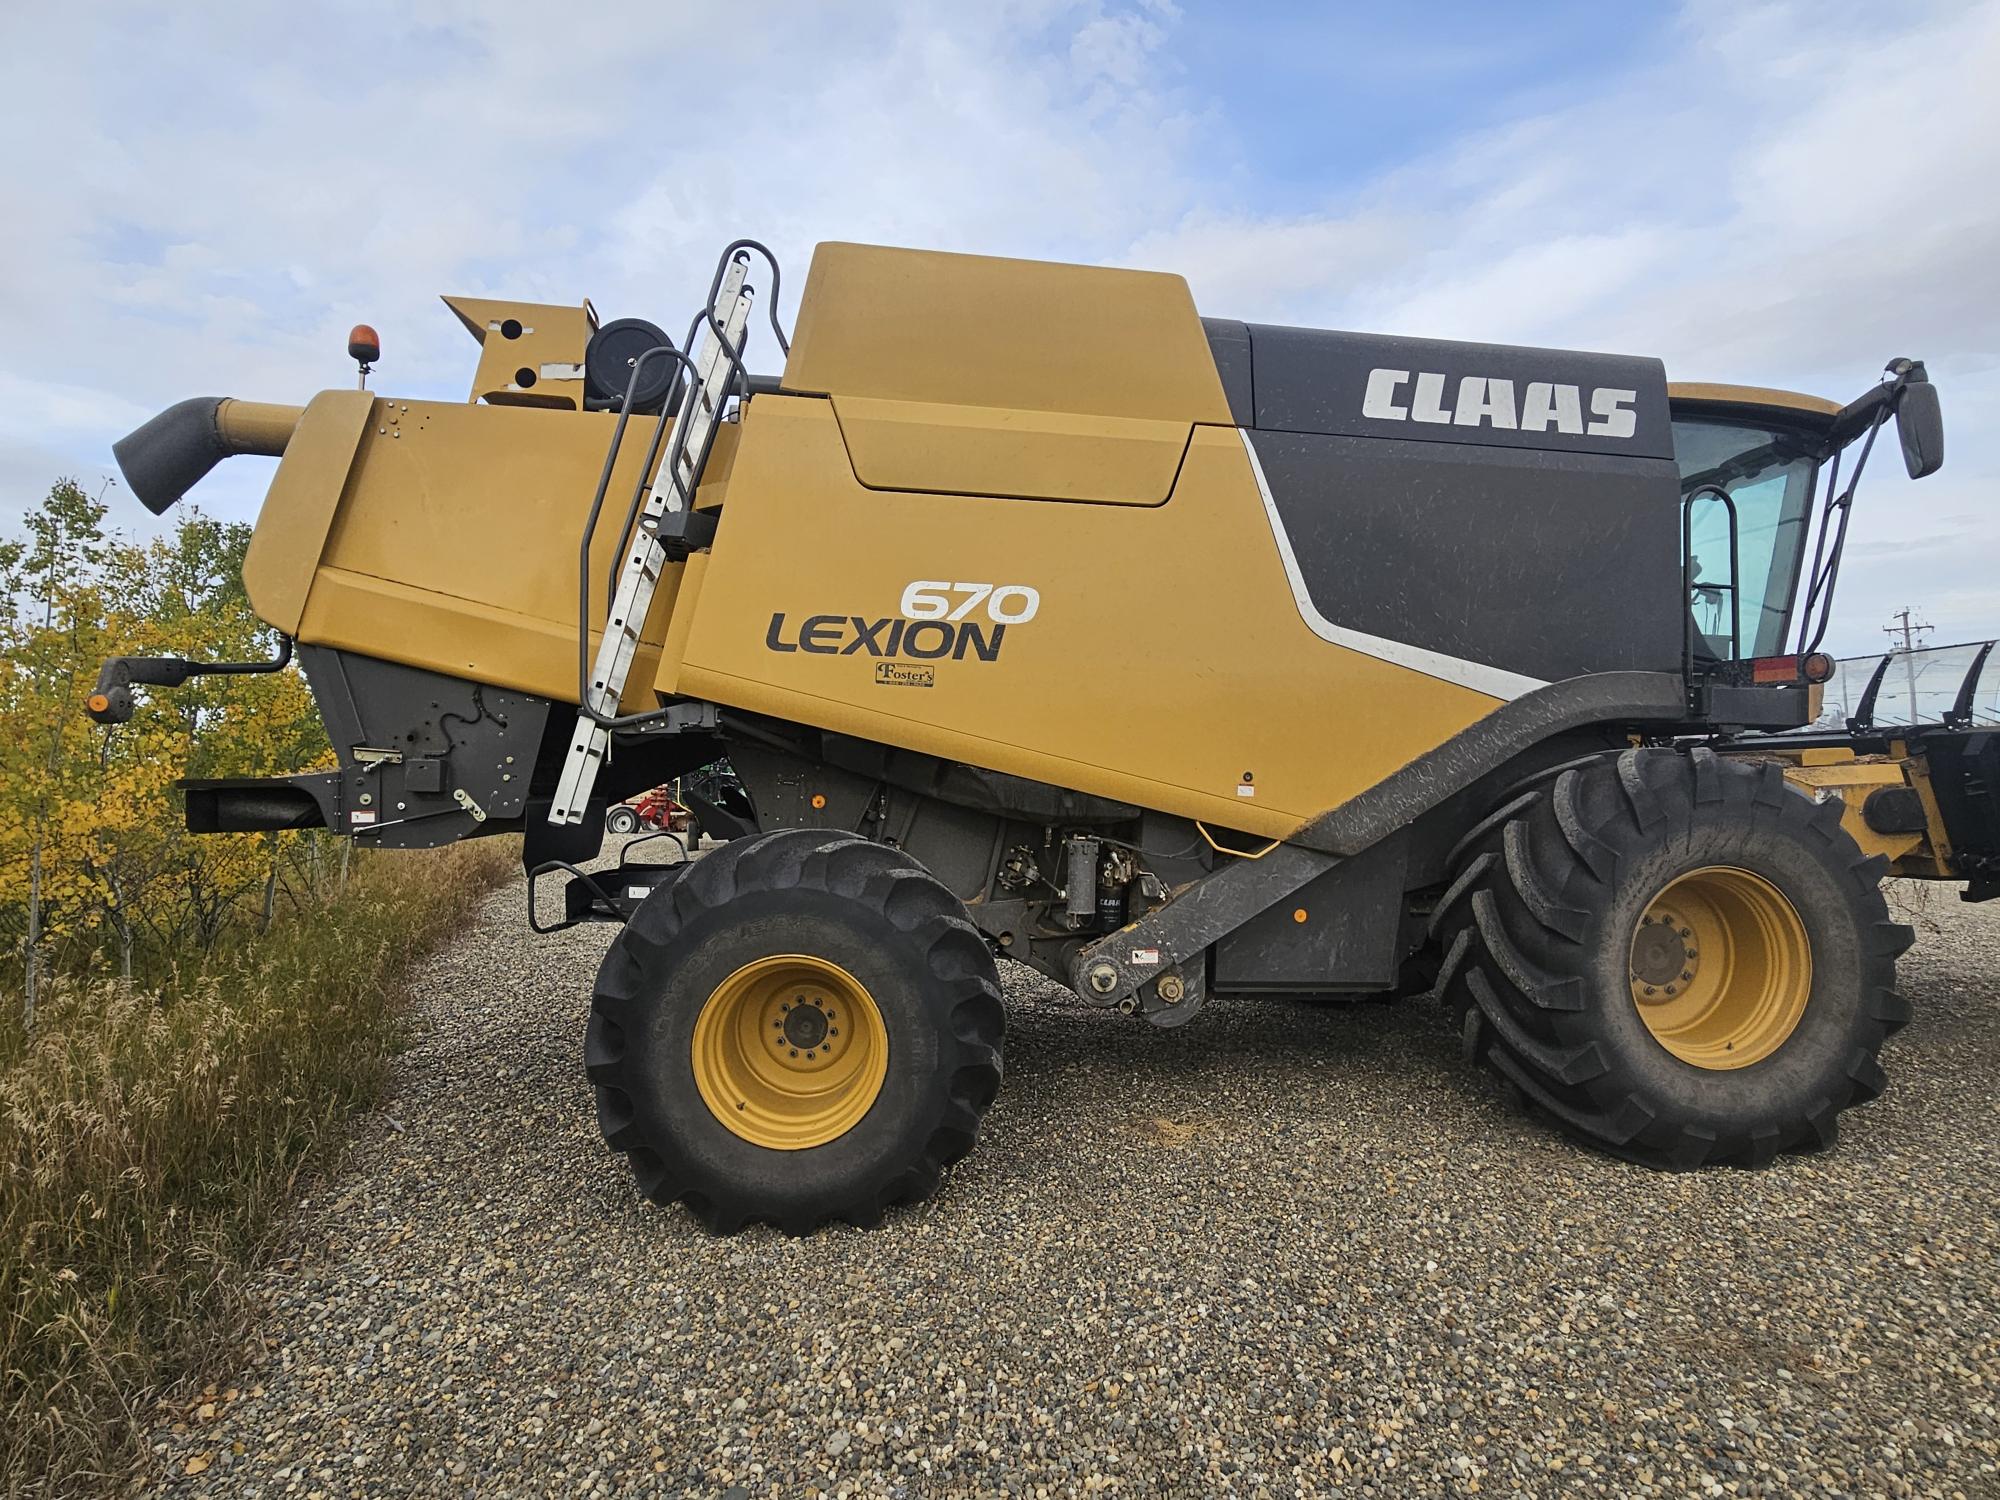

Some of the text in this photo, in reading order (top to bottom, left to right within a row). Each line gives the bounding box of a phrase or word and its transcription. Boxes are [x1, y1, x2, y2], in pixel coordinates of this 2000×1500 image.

[1362, 368, 1637, 438] CLAAS
[901, 581, 1040, 624] 670
[766, 613, 1006, 661] LEXION
[877, 663, 933, 682] Foster's
